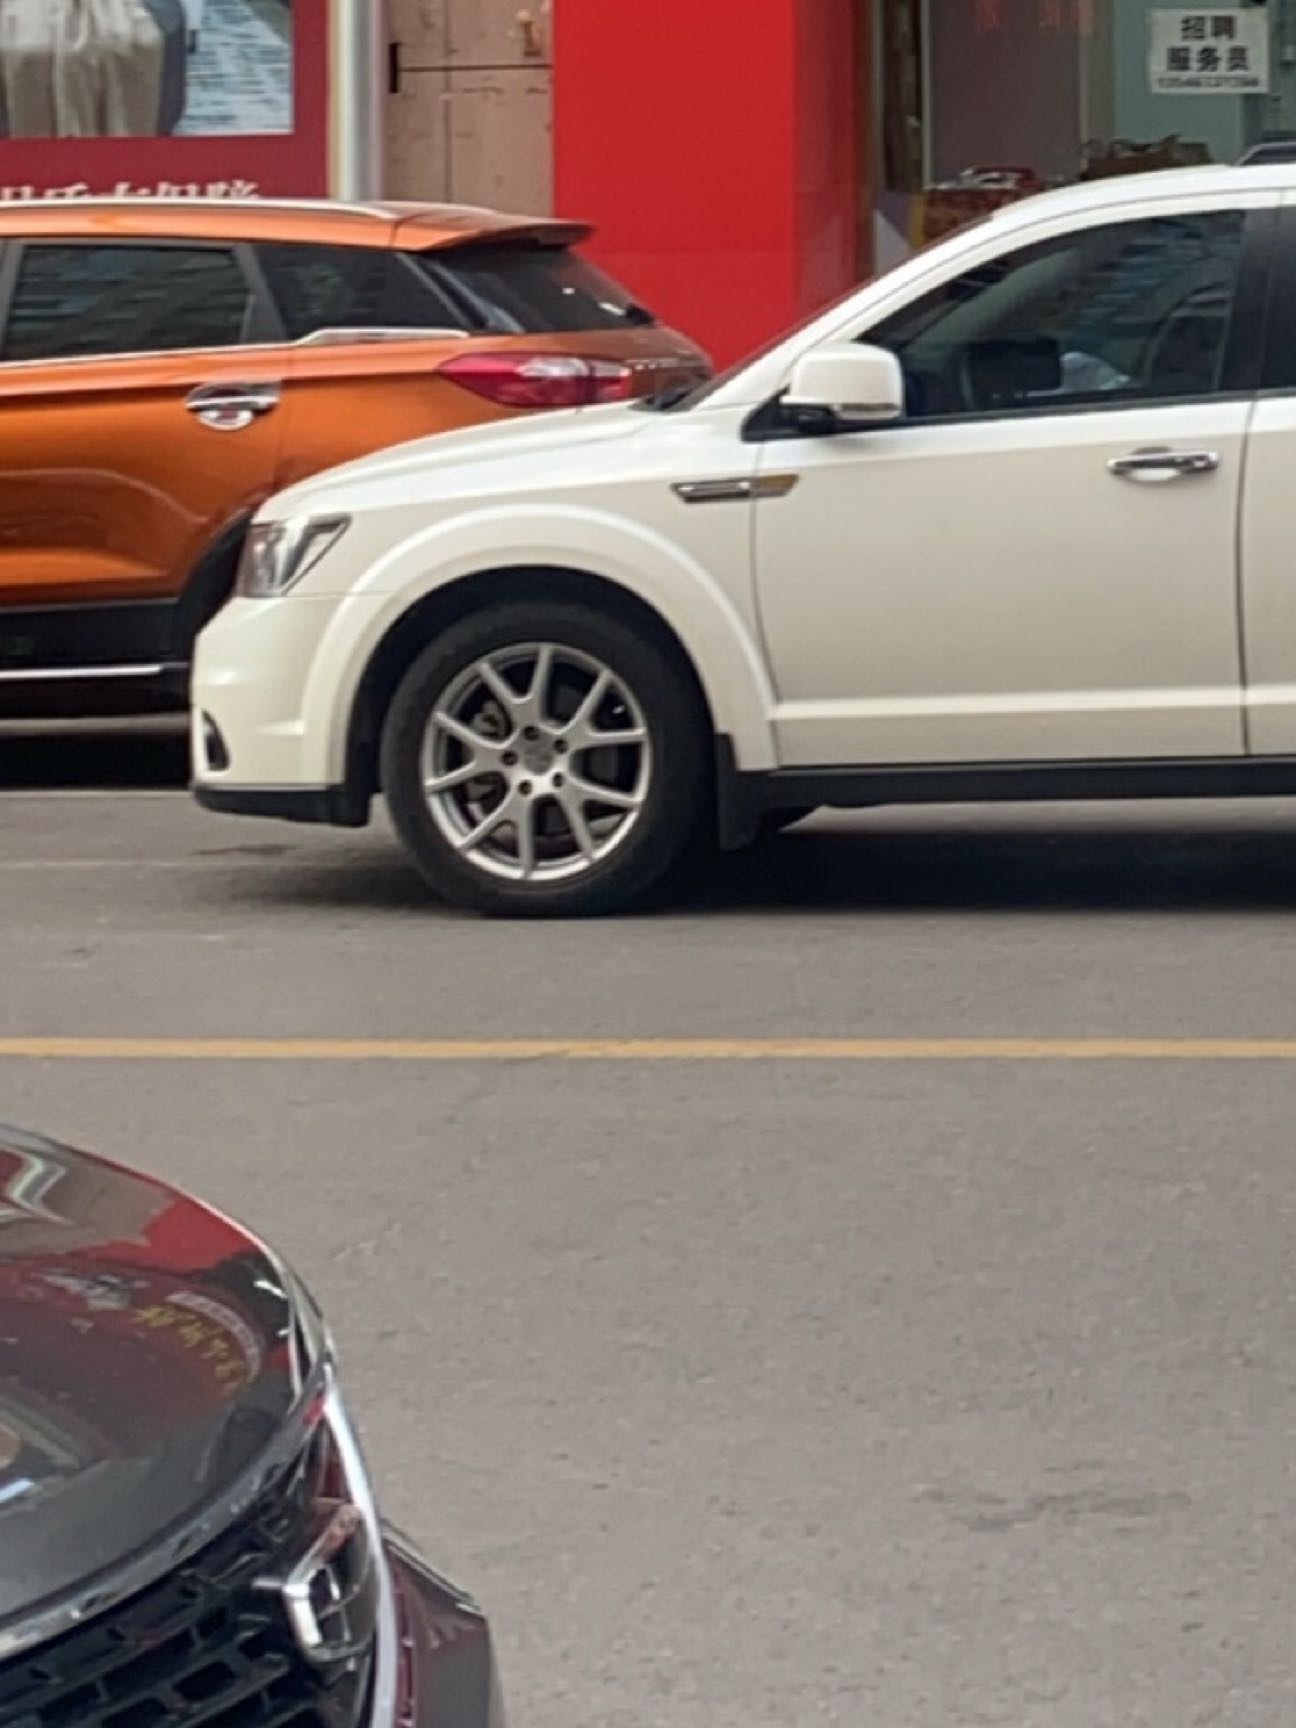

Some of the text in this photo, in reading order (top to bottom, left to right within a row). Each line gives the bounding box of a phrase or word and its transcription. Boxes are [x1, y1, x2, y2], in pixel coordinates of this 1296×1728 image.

[1180, 15, 1236, 41] 招聘
[1166, 46, 1249, 72] 服务员
